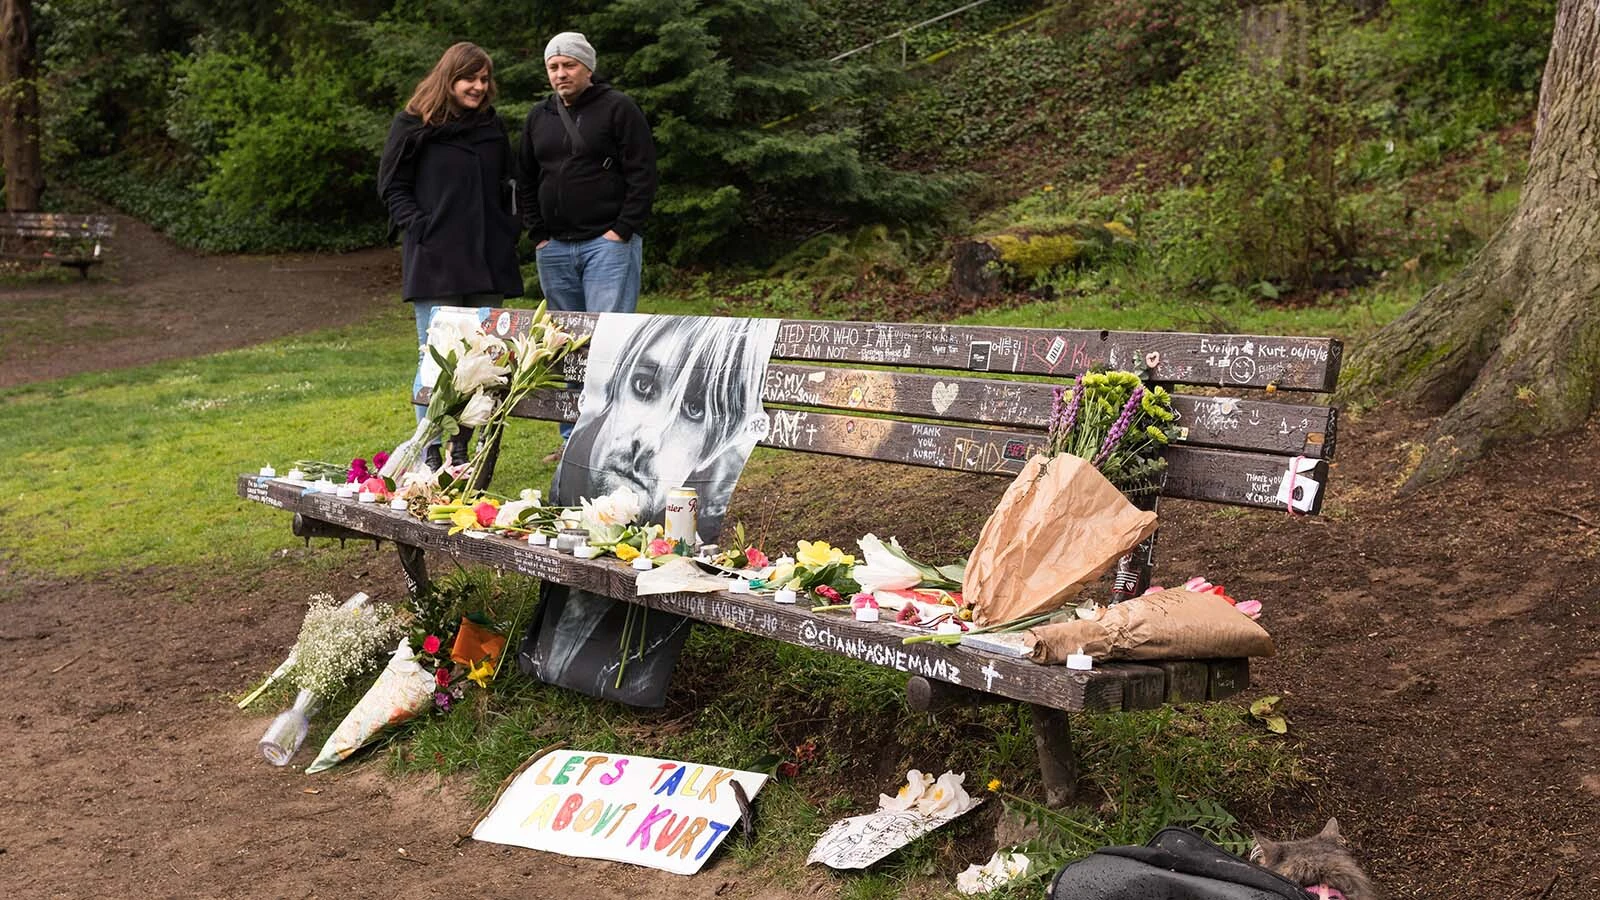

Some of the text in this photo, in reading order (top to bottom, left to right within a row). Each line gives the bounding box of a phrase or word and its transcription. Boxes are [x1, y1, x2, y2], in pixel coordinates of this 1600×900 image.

[776, 323, 805, 344] ATED
[808, 325, 831, 344] FOR
[833, 327, 859, 346] WHO
[863, 328, 875, 348] I
[773, 343, 787, 358] HO
[789, 344, 800, 357] I
[803, 344, 821, 358] AM
[765, 369, 784, 389] ES
[761, 387, 791, 402] ANA?
[912, 425, 941, 437] THANK
[649, 765, 735, 804] TALK
[519, 792, 730, 862] ABOUT KURT
